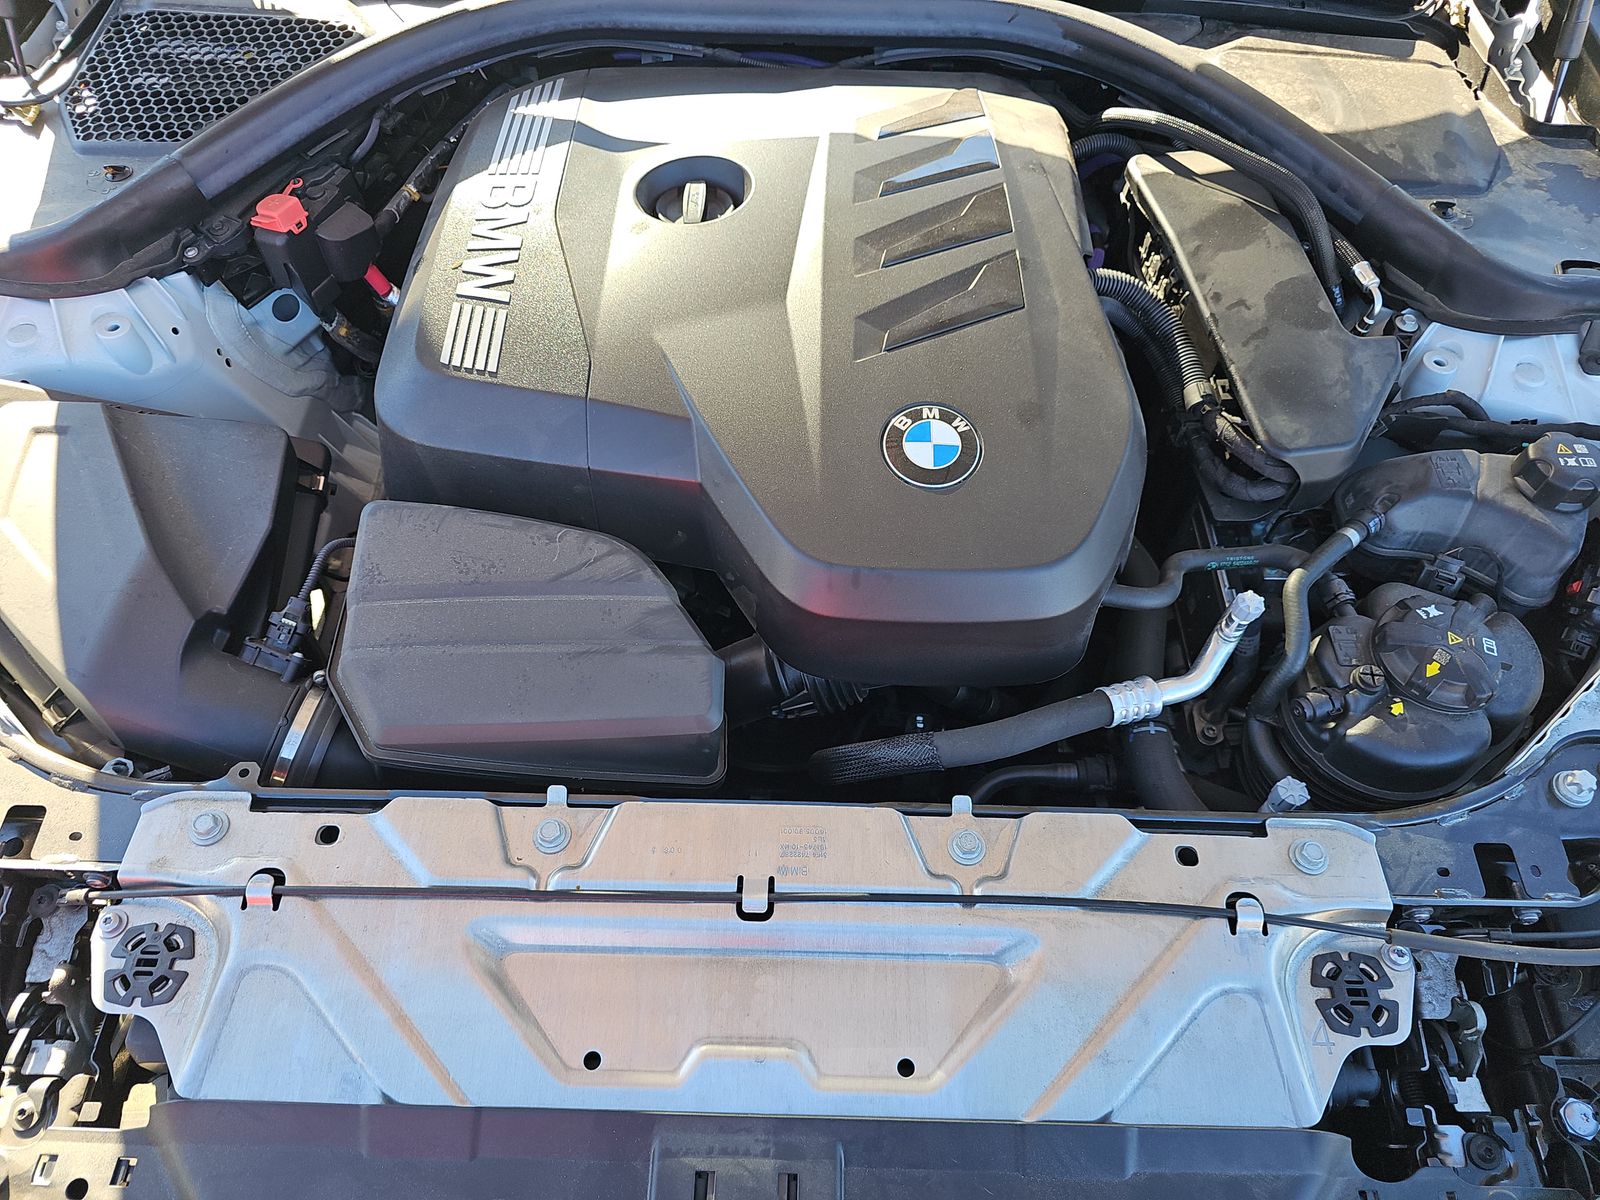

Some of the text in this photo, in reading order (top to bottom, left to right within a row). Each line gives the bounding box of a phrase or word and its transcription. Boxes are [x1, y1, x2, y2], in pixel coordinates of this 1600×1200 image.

[455, 177, 537, 305] BMW
[893, 407, 970, 433] BMW
[777, 866, 808, 876] BMW
[1312, 1018, 1335, 1055] 4
